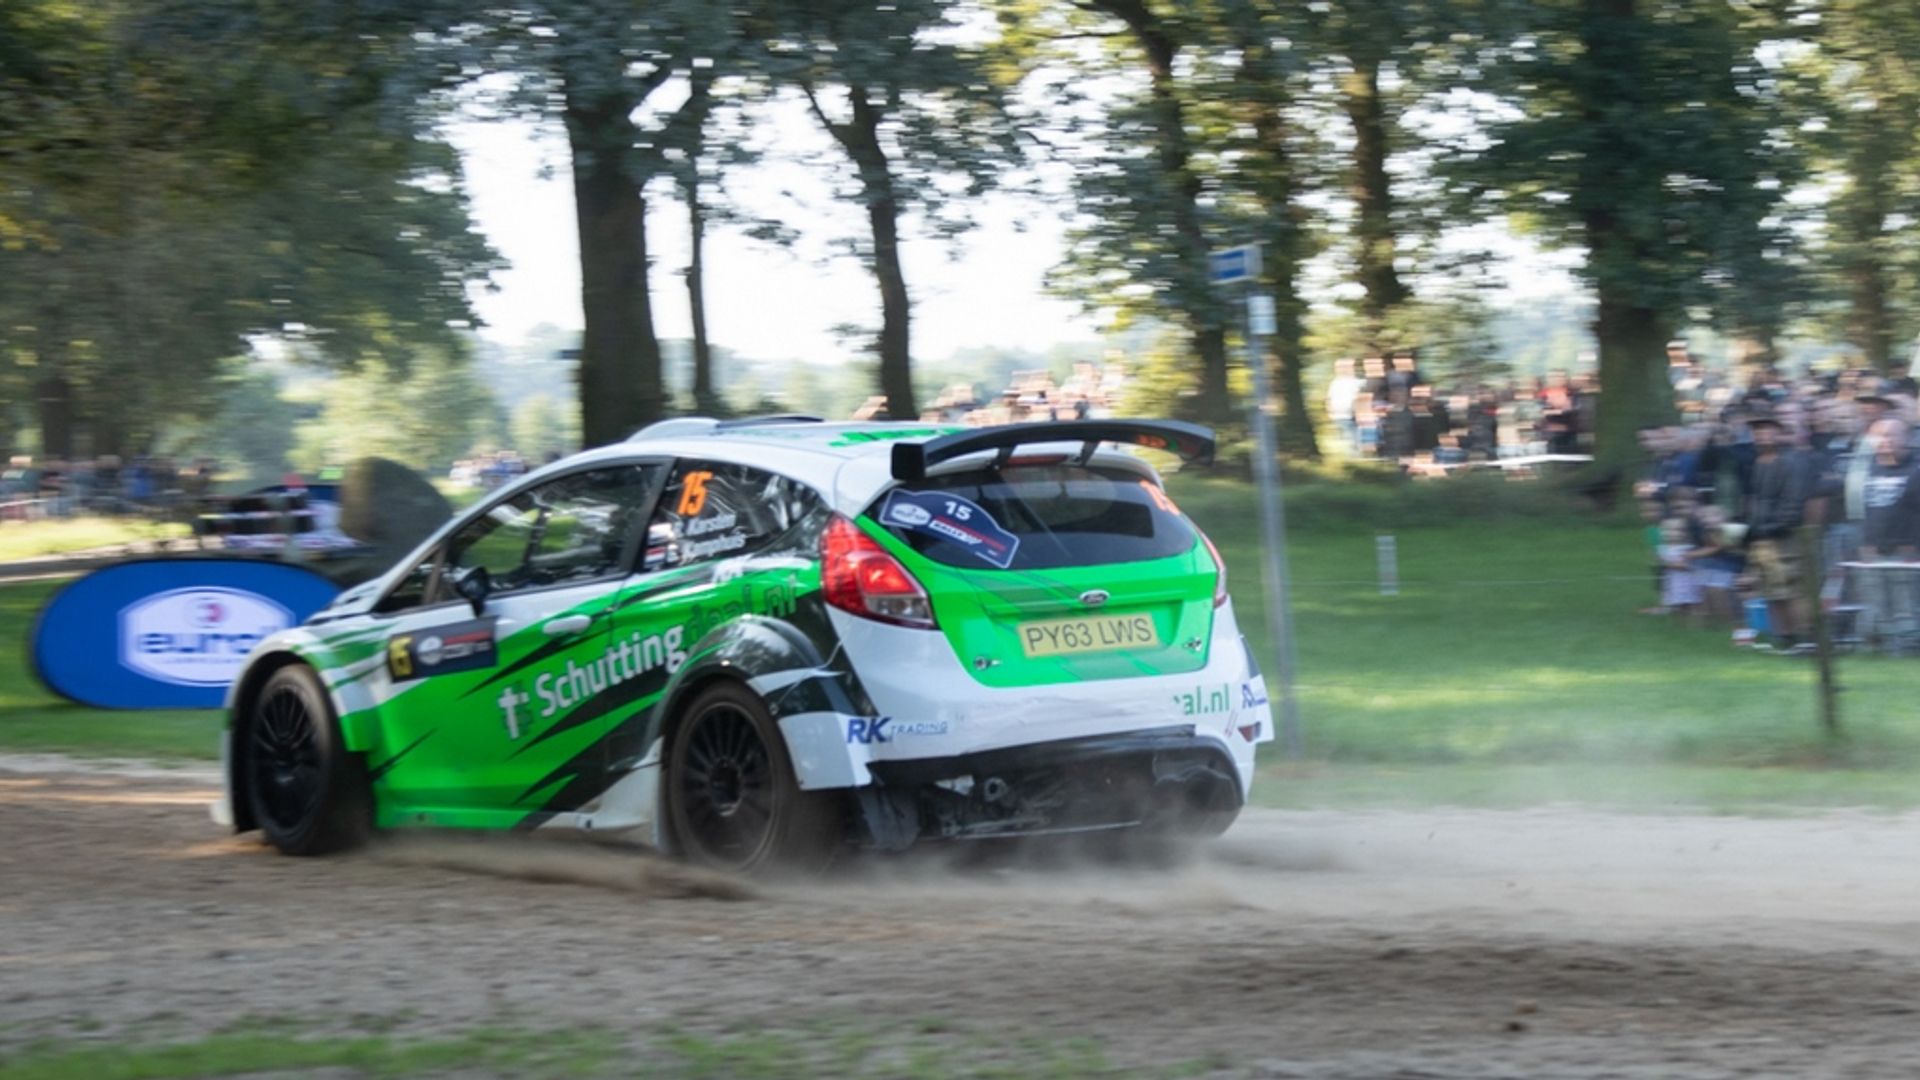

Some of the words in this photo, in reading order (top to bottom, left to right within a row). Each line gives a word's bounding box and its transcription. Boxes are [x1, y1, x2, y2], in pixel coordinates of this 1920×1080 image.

[678, 471, 713, 517] 15
[944, 501, 973, 520] 15
[139, 628, 270, 654] euro
[535, 573, 797, 717] Schuttingdealnl
[1026, 622, 1093, 652] PY63
[1098, 617, 1152, 646] LWS
[889, 721, 949, 737] TRADING
